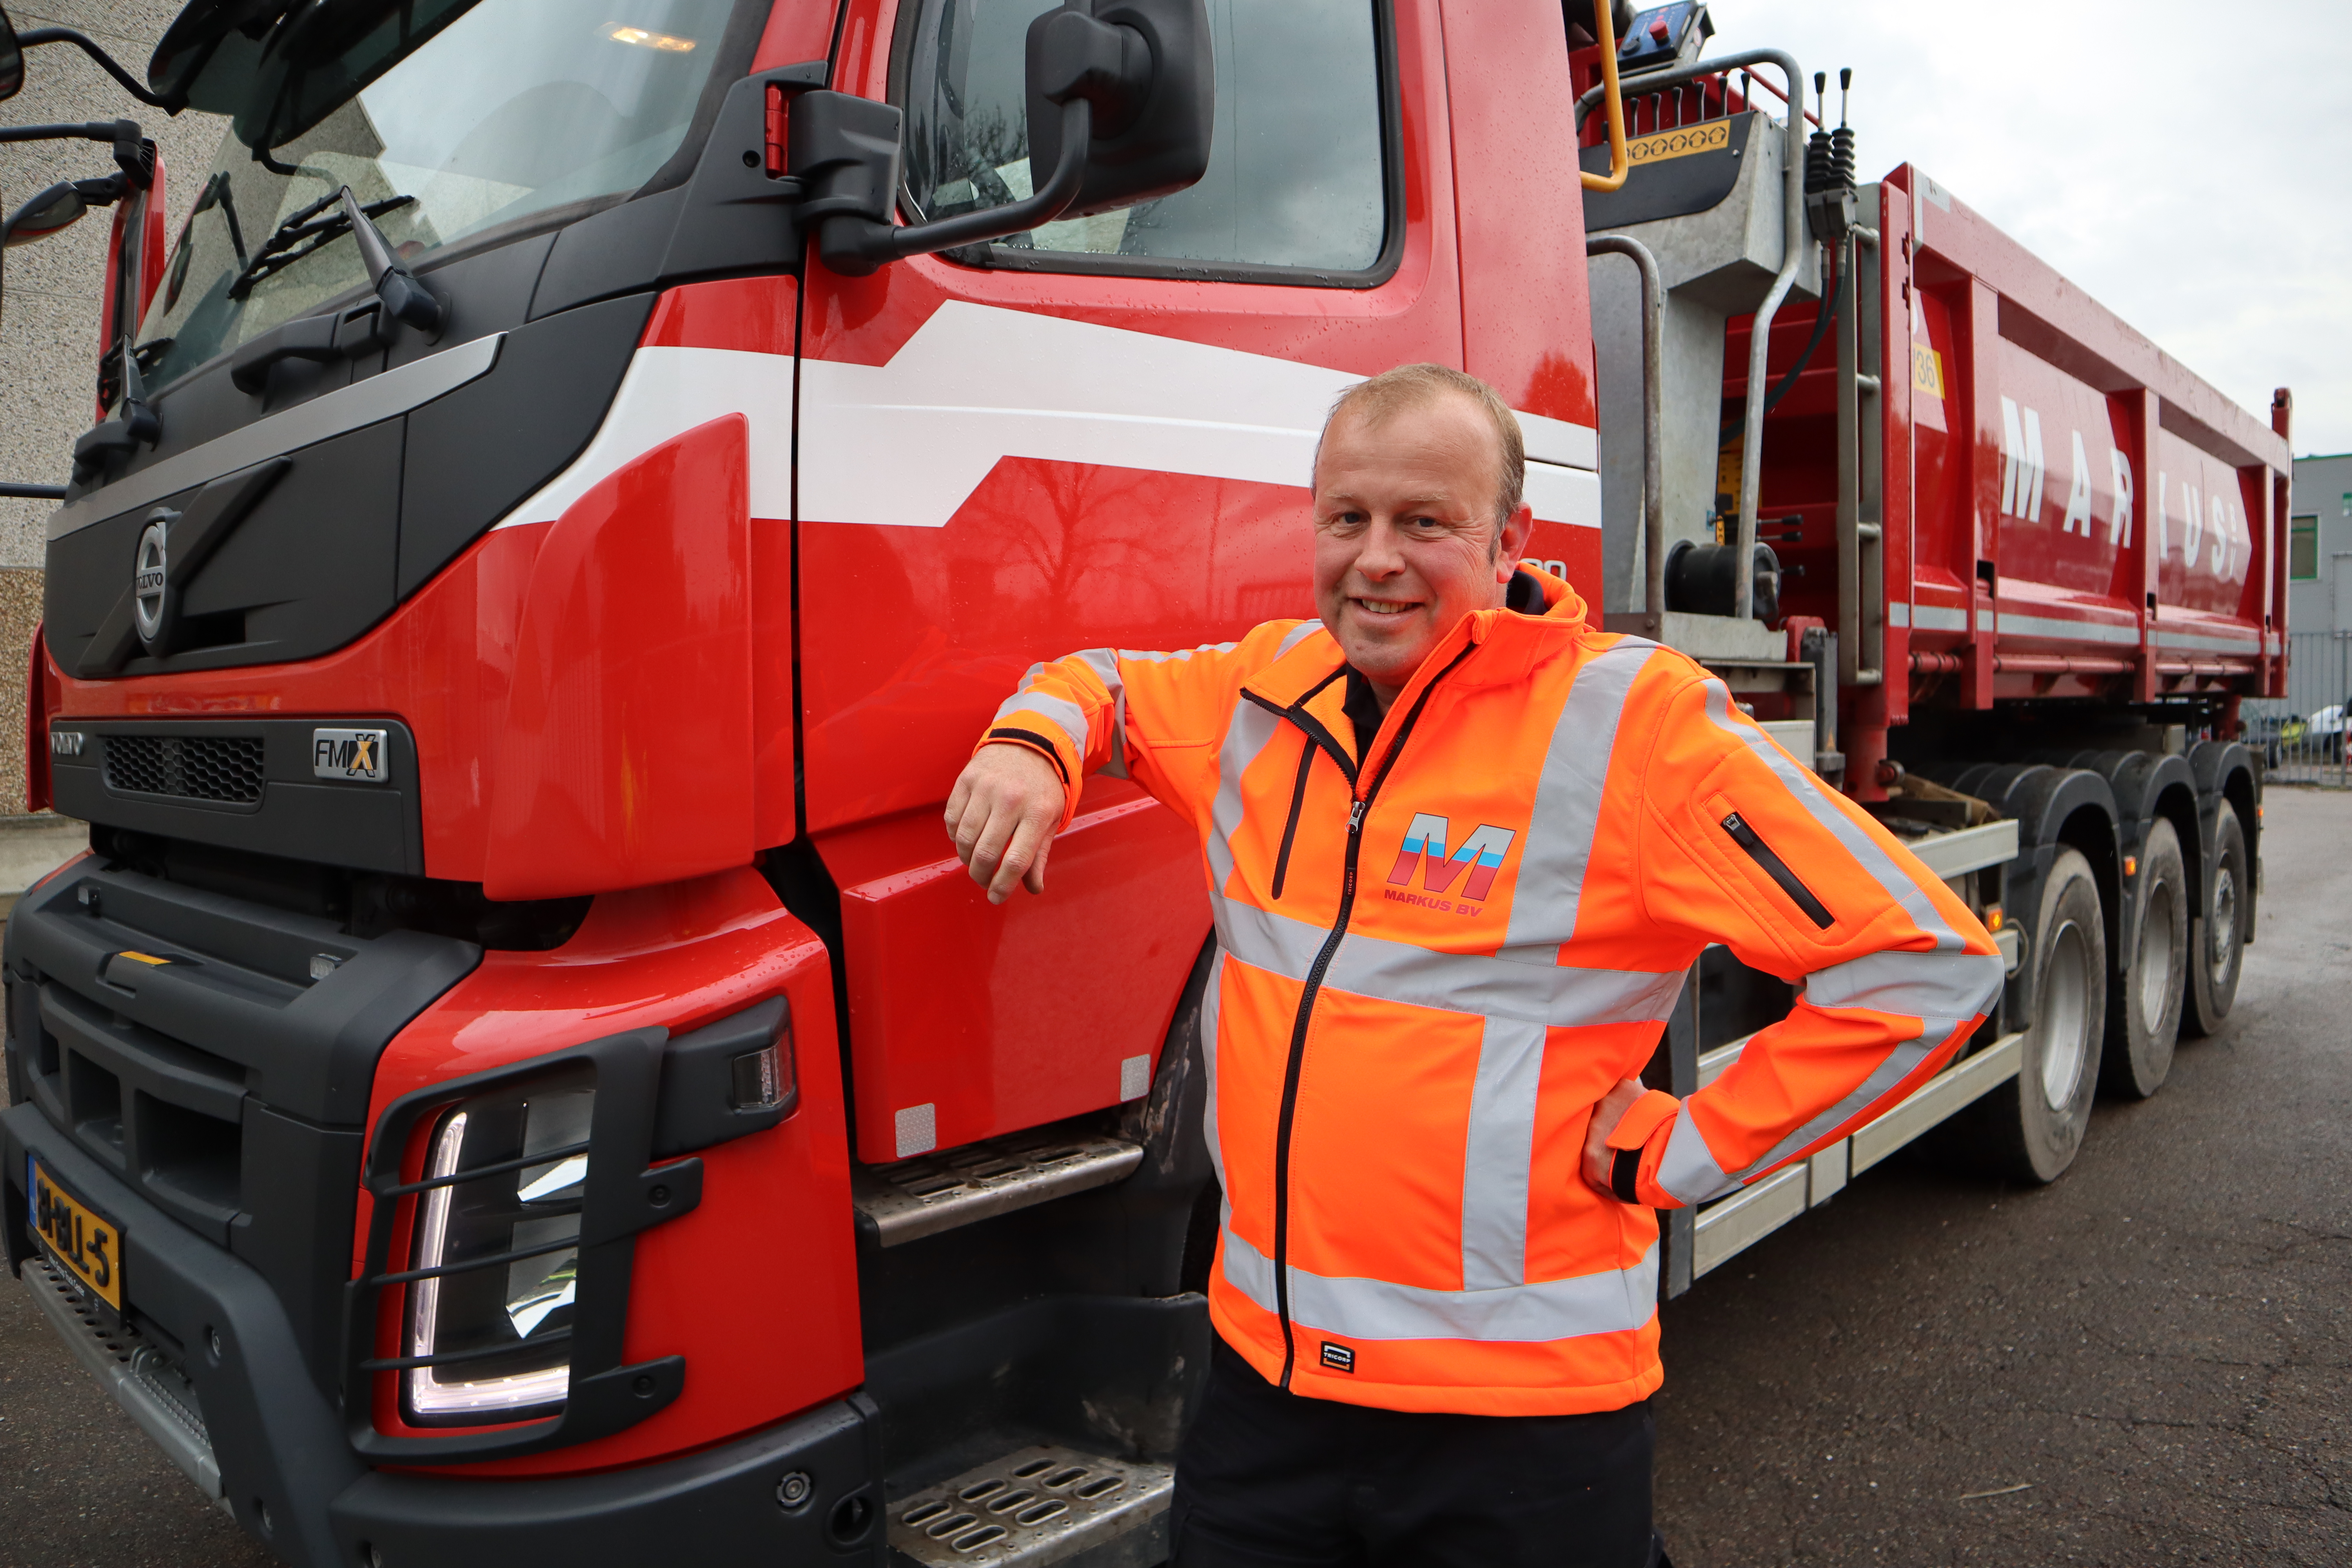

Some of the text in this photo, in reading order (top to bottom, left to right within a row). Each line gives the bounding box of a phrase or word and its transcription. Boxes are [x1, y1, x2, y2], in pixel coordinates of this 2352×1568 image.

[2001, 394, 2227, 575] MARUS
[315, 733, 376, 777] FMX
[1387, 812, 1517, 902] M
[1384, 889, 1483, 918] MARKUS BV
[1323, 1352, 1351, 1363] TRICORP
